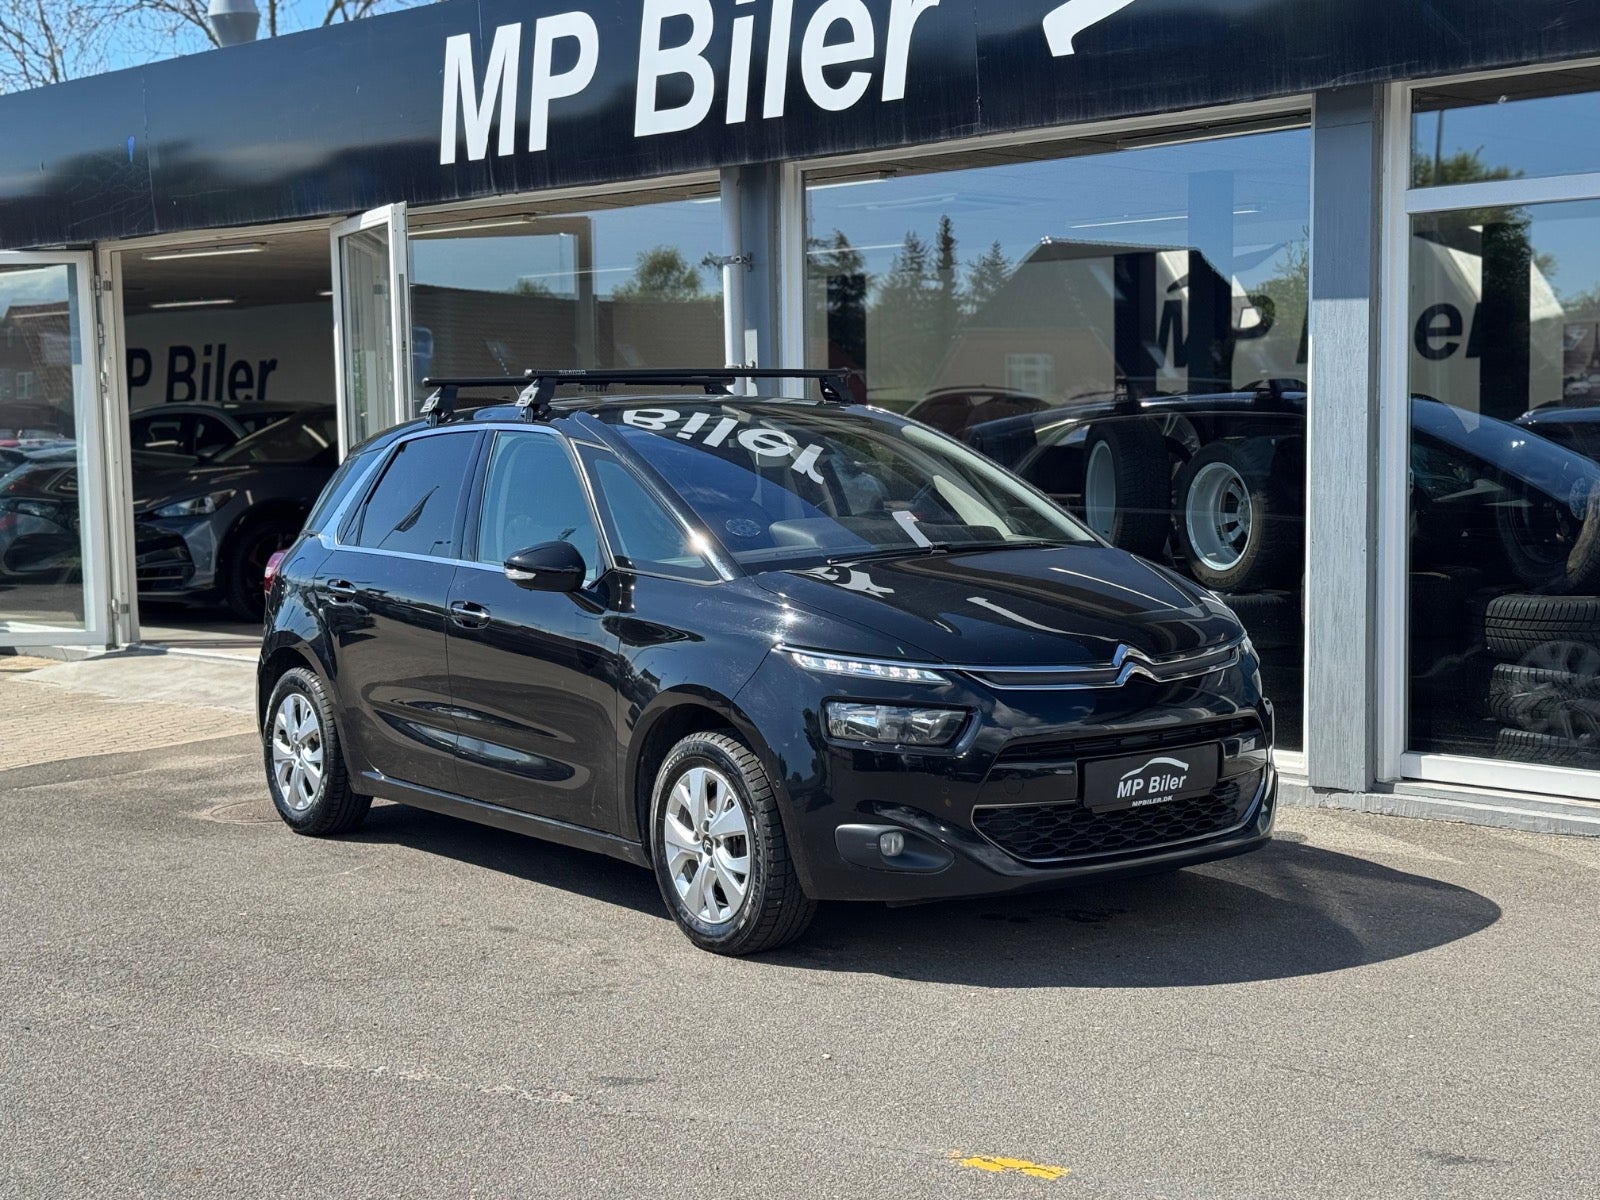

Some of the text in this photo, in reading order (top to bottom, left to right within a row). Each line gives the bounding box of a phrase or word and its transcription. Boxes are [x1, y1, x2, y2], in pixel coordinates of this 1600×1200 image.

[440, 0, 942, 165] MP Biler
[166, 343, 278, 402] Biler
[1117, 774, 1187, 799] MP Biler
[1131, 795, 1173, 807] MPBILER.DK
